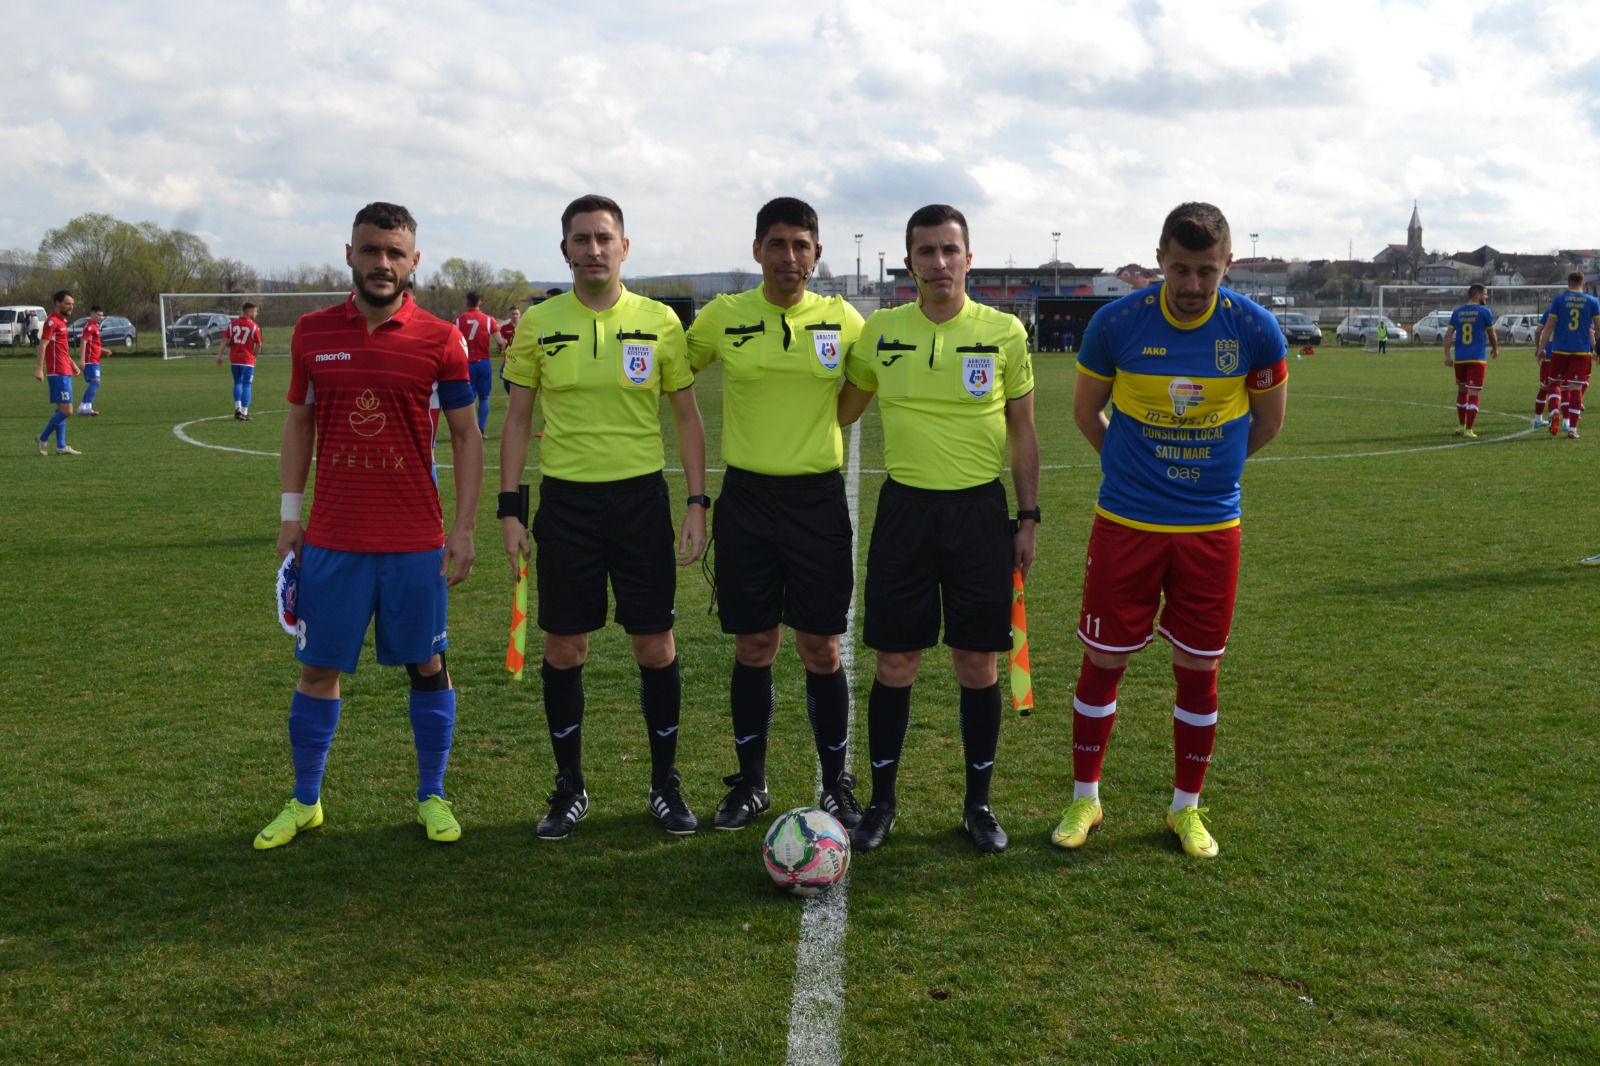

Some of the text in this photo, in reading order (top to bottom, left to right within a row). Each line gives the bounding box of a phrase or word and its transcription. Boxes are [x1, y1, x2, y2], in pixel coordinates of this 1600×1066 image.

[1568, 308, 1580, 331] 3
[232, 325, 251, 345] 27
[466, 319, 479, 341] 7
[1462, 323, 1473, 345] 8
[315, 351, 351, 362] macron
[1142, 346, 1167, 356] JAKO
[61, 391, 70, 401] 13
[1144, 411, 1219, 428] m-sys.ro
[1142, 425, 1224, 441] CONSILIUL LOCAL
[1155, 445, 1211, 460] SATU MARE
[332, 454, 404, 469] FELIX
[1085, 613, 1101, 638] 11
[1072, 742, 1101, 752] JAKO
[1184, 752, 1212, 763] JAKO
